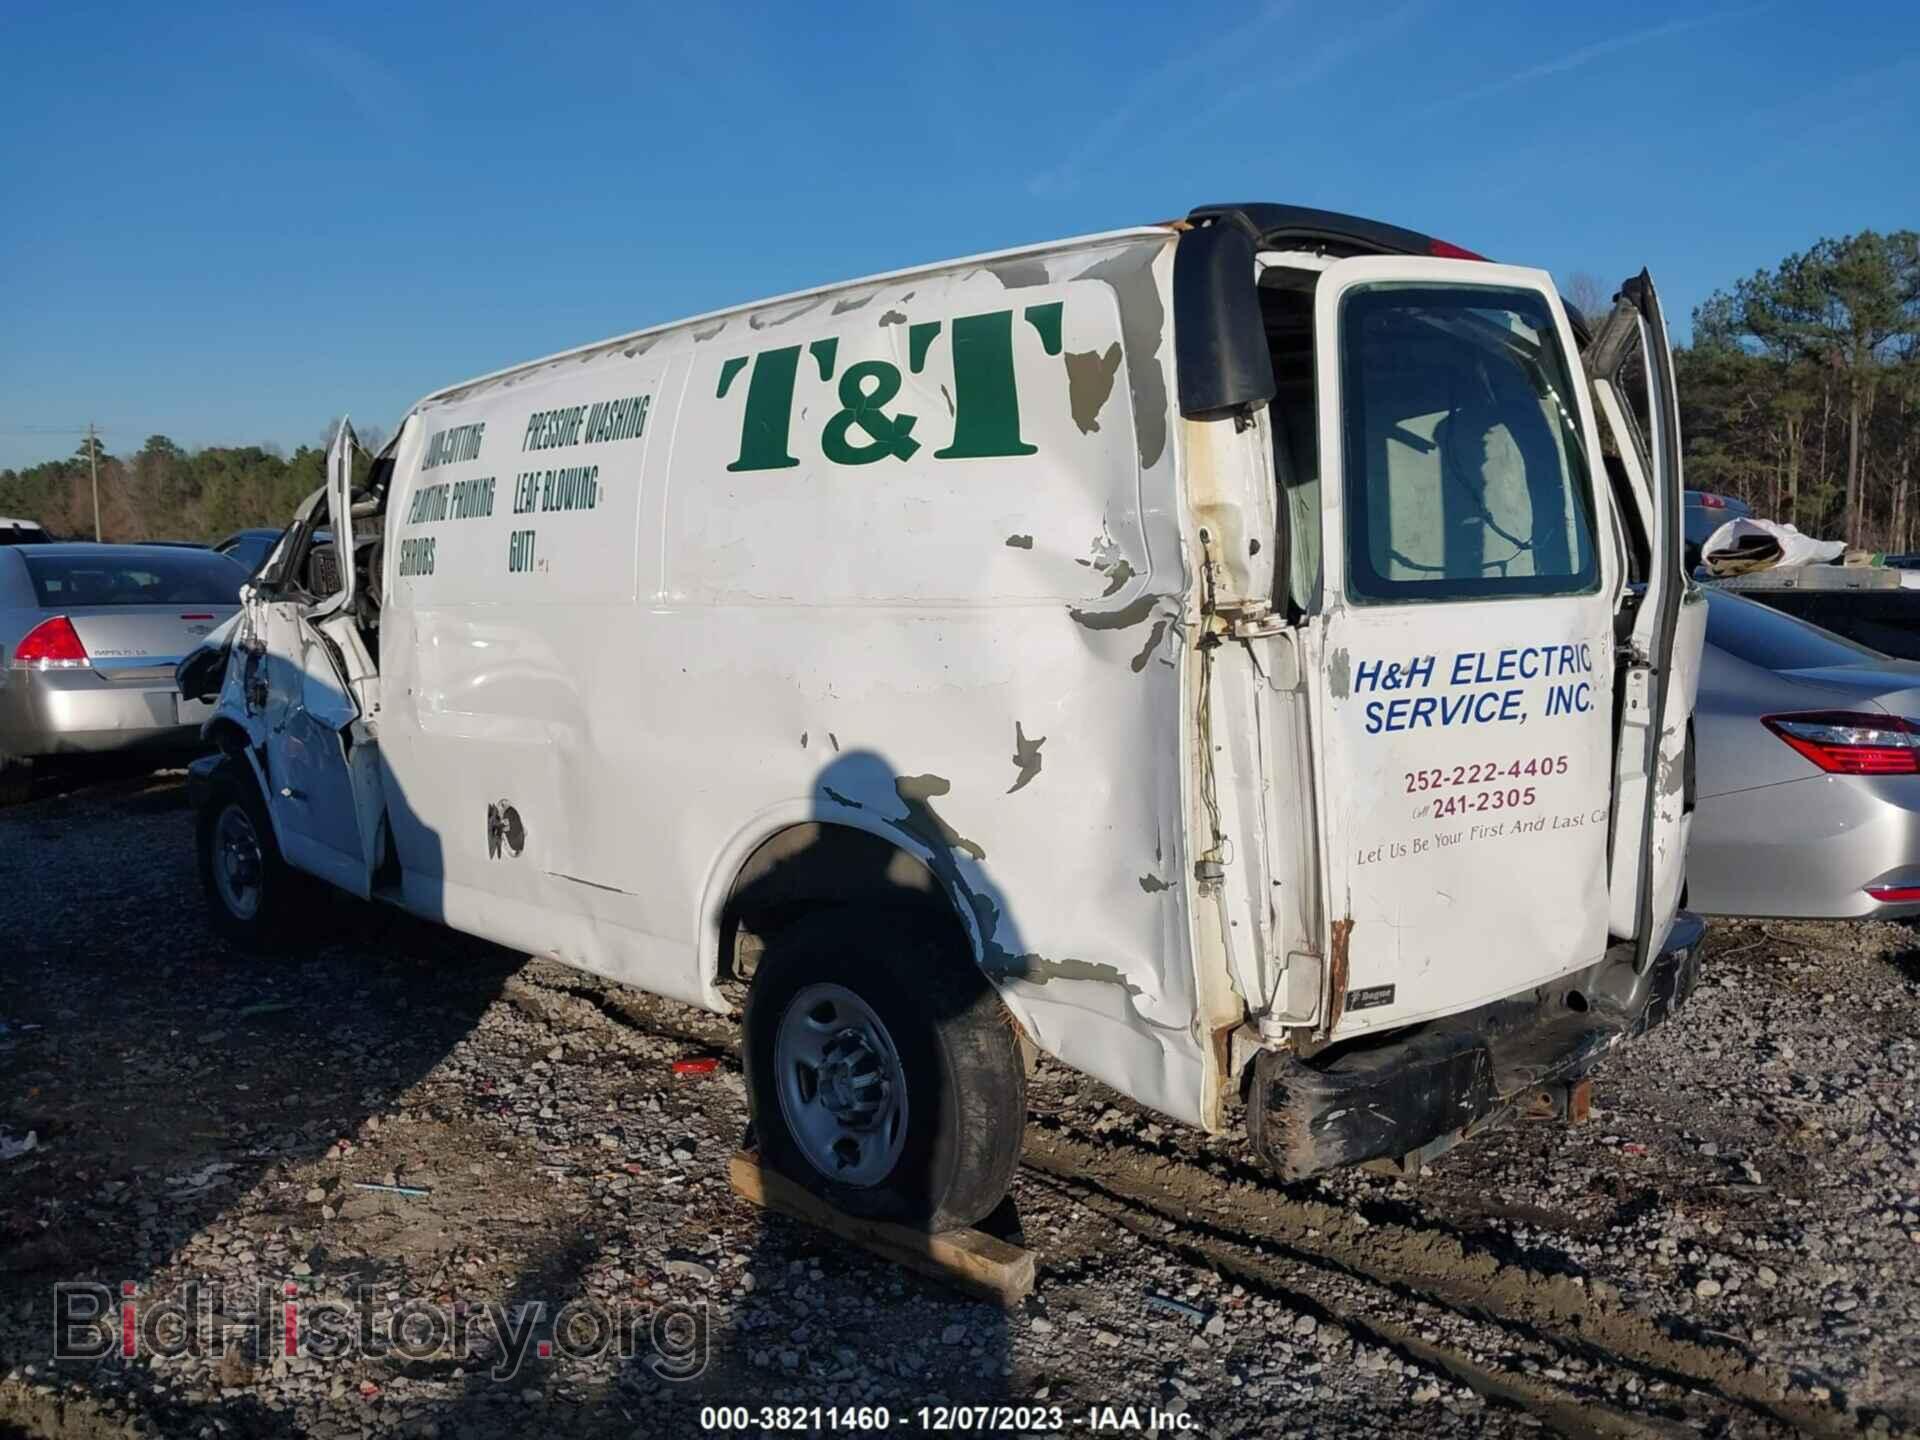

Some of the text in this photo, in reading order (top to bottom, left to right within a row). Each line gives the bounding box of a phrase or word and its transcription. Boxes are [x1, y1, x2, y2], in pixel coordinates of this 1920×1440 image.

[716, 301, 1064, 472] T&T
[522, 394, 651, 453] PRESSURE WASHING
[449, 477, 496, 520] PRUNING
[513, 465, 599, 514] LEAF BLOWING
[399, 537, 436, 576] SHRUBS
[1354, 643, 1593, 693] H&H ELECTRIC
[1365, 682, 1595, 735] SERVICE, INC.
[1405, 755, 1569, 793] 252-222-4405
[1433, 787, 1536, 819] 241-2305
[1357, 848, 1382, 866] Let
[1390, 842, 1407, 859] Us
[1413, 837, 1429, 855] Be
[1434, 831, 1464, 849] Your
[1469, 823, 1504, 841] First
[1510, 816, 1546, 835] And
[1552, 813, 1585, 830] Last
